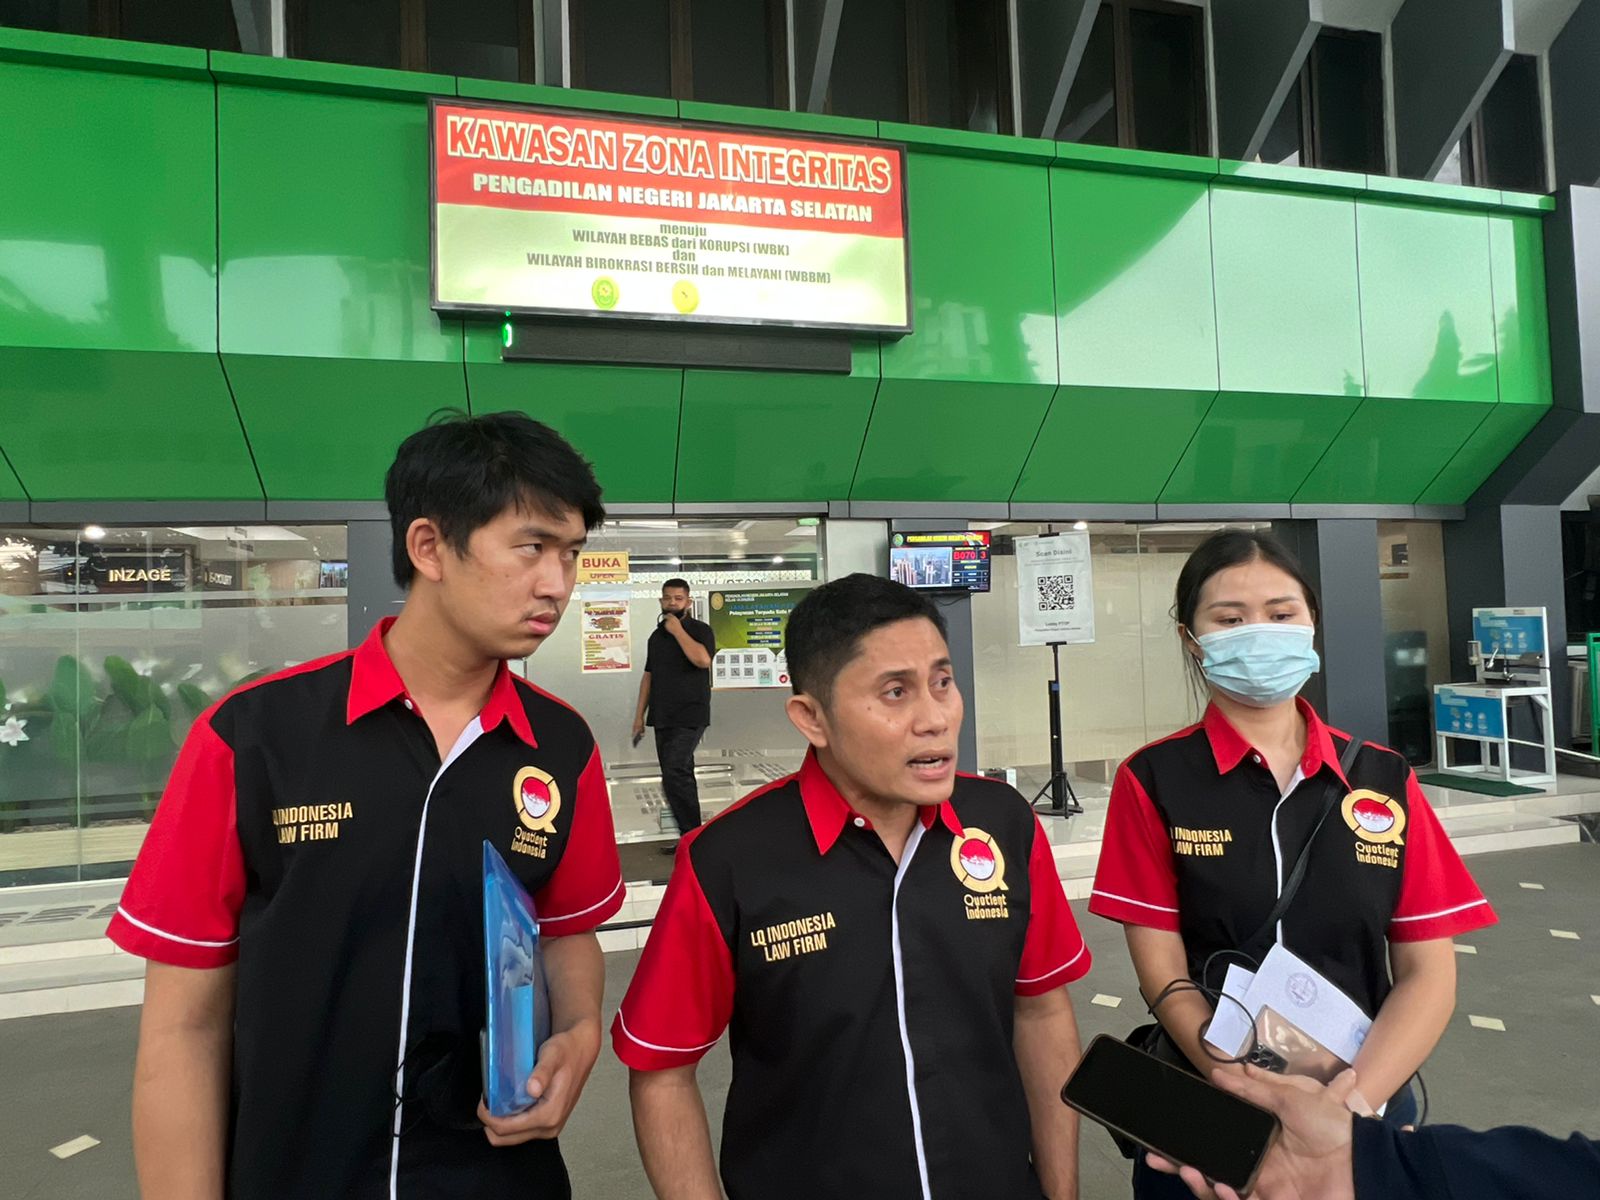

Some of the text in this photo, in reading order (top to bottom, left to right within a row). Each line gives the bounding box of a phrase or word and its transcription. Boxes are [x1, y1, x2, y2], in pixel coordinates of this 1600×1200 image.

[447, 115, 892, 193] KAWASAN ZONA INTEGRITAS
[473, 173, 872, 222] PENGADILAN NEGERI JAKARTA SELATAN
[660, 223, 707, 237] menuju
[572, 229, 790, 256] WILAYAH BEBAS dari KORUPSI (WBK)
[672, 250, 696, 262] dan
[527, 253, 831, 284] WILAYAH BIROKRASI BERSIH dan MELAYANI (WBBM)
[582, 558, 621, 568] BUKA
[953, 551, 987, 560] B070 3
[109, 569, 171, 582] INZAGE
[301, 822, 339, 842] FIRM
[1174, 826, 1233, 843] INDONESIA
[1194, 843, 1224, 856] FIRM
[1355, 841, 1399, 858] Quotient
[963, 893, 1007, 907] Quotient
[965, 903, 1009, 920] Indonesia
[750, 911, 836, 947] LQ INDONESIA
[764, 932, 827, 962] LAW FIRM
